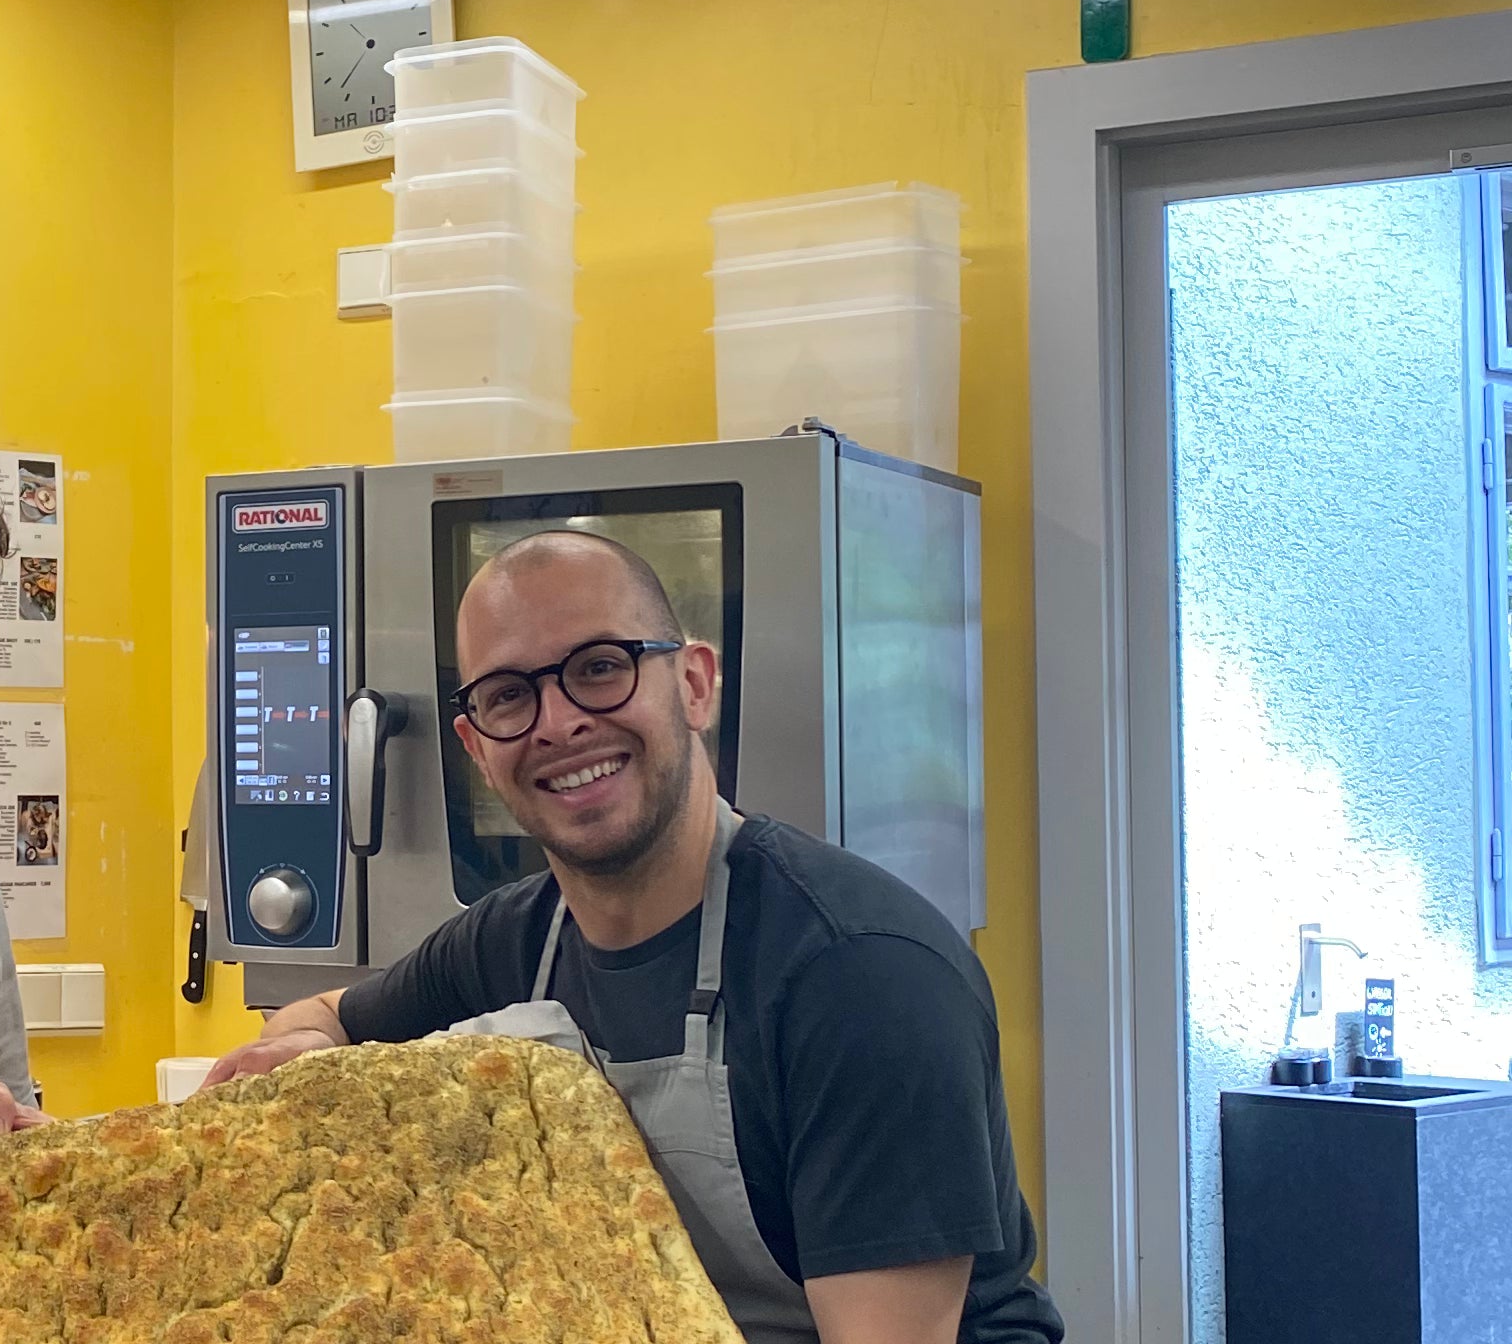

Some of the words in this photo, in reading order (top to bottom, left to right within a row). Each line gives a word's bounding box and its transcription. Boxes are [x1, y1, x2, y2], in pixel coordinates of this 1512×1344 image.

[238, 507, 324, 526] RATIONAL
[238, 541, 311, 553] SelfCookingCenter
[312, 539, 324, 549] XS
